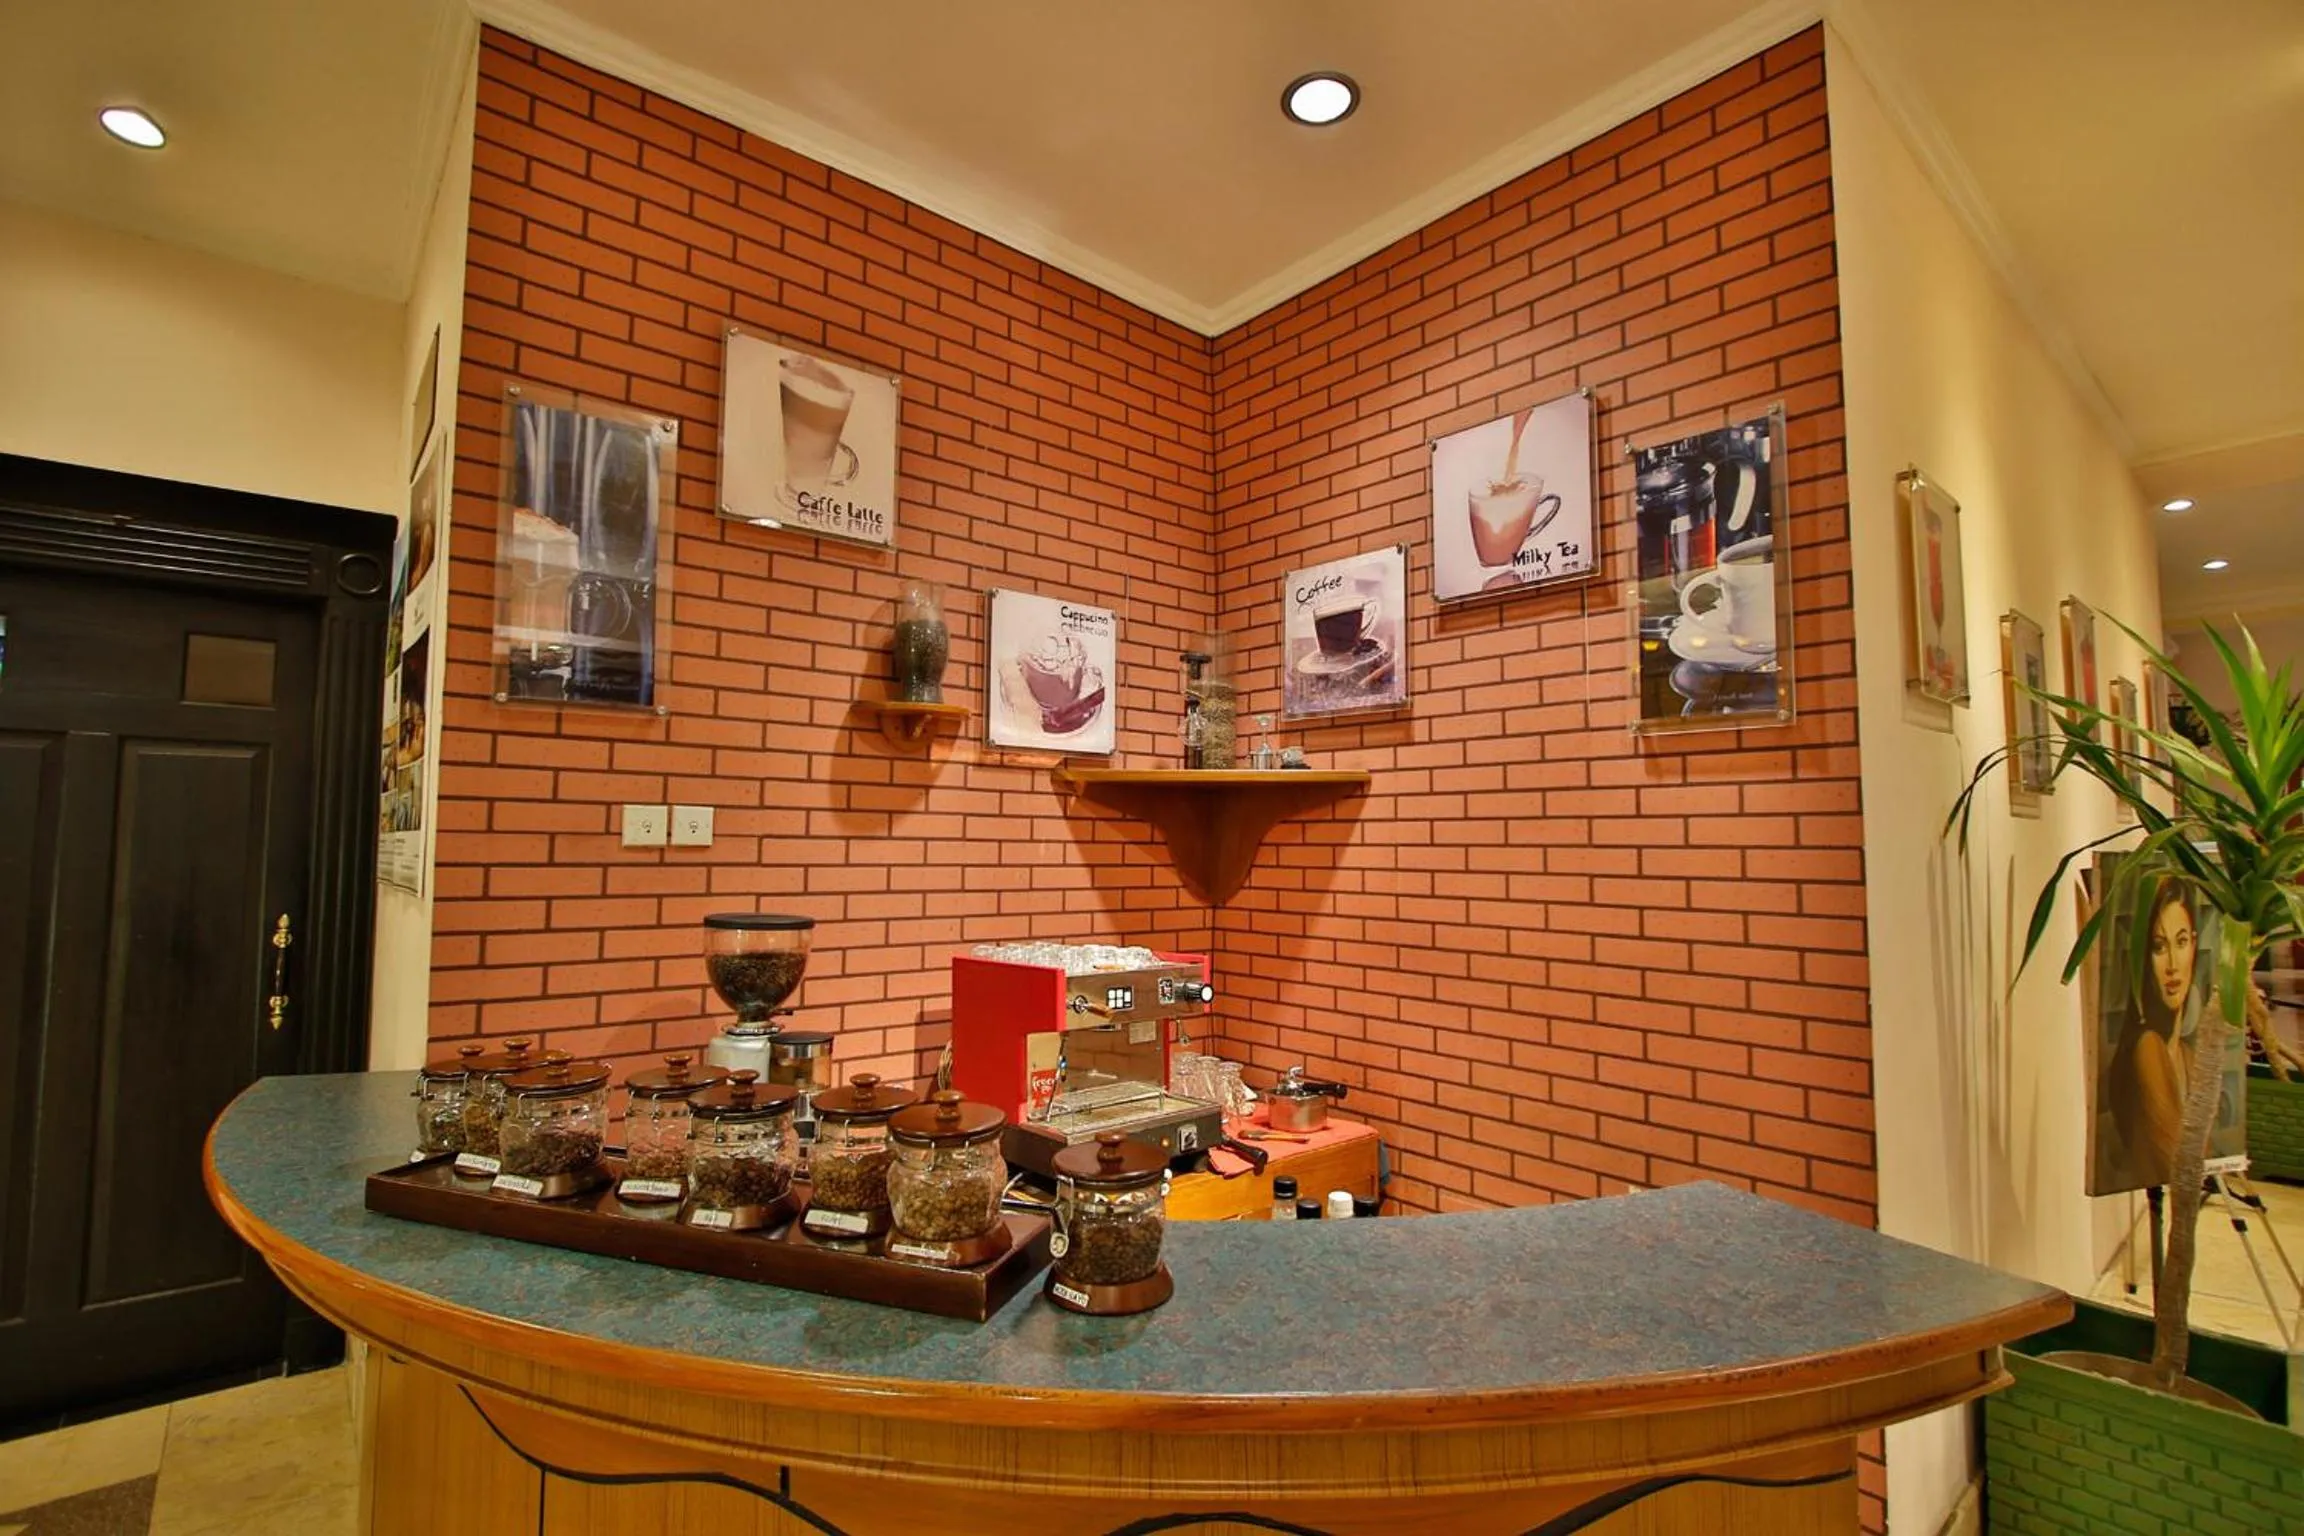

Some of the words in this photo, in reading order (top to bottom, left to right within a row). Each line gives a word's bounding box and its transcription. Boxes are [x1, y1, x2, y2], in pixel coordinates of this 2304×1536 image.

[797, 490, 842, 515] Caffe
[847, 501, 884, 524] Latte
[1512, 547, 1552, 567] Milky
[1556, 541, 1579, 557] Tea
[1295, 575, 1342, 603] Coffee
